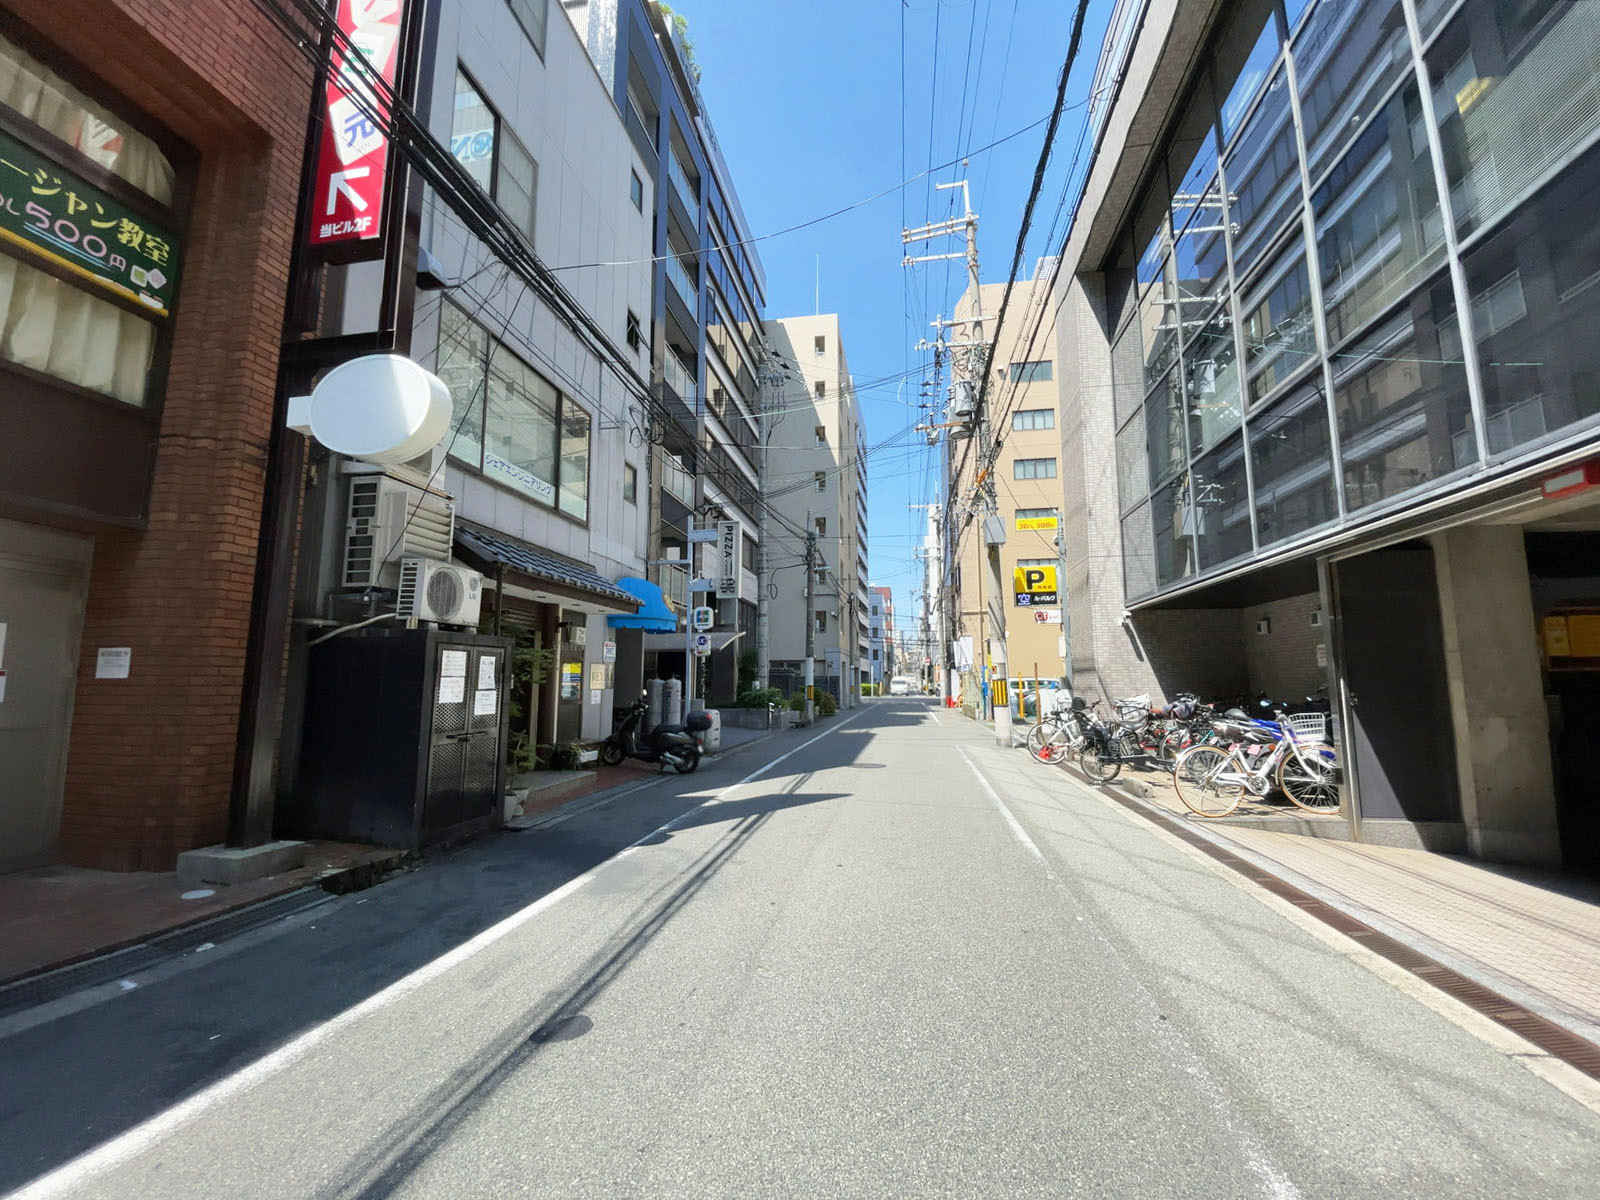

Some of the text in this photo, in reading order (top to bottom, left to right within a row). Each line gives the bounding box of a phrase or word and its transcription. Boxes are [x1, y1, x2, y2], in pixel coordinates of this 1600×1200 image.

[319, 216, 372, 238] 当ビル2F
[724, 525, 734, 558] PIZZA
[1026, 570, 1044, 590] P
